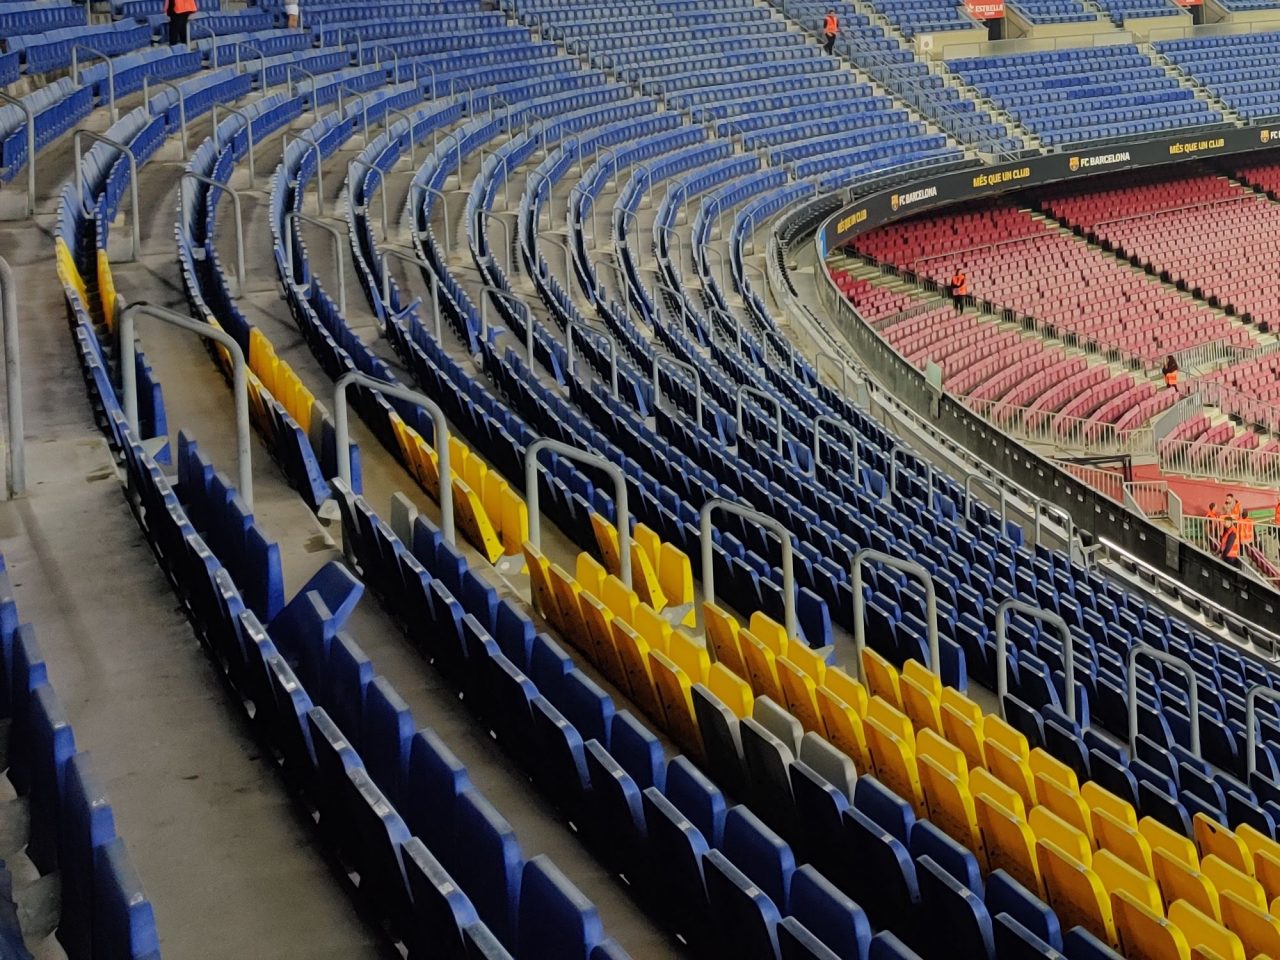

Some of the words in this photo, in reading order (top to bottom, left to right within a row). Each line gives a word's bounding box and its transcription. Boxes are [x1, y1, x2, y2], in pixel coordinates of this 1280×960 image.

[976, 4, 1004, 12] ESTRELLA
[1270, 130, 1278, 139] FC
[1170, 141, 1184, 154] MÉS
[1185, 140, 1198, 153] QUE
[1198, 139, 1208, 149] UN
[1209, 138, 1224, 148] CLUB
[1080, 157, 1090, 167] FC
[1090, 152, 1130, 166] BARCELONA
[974, 173, 987, 187] MÉS
[988, 171, 1002, 185] QUE
[1002, 170, 1012, 181] UN
[1013, 168, 1030, 180] CLUB
[899, 194, 905, 206] FC
[906, 186, 937, 204] BARCELONA
